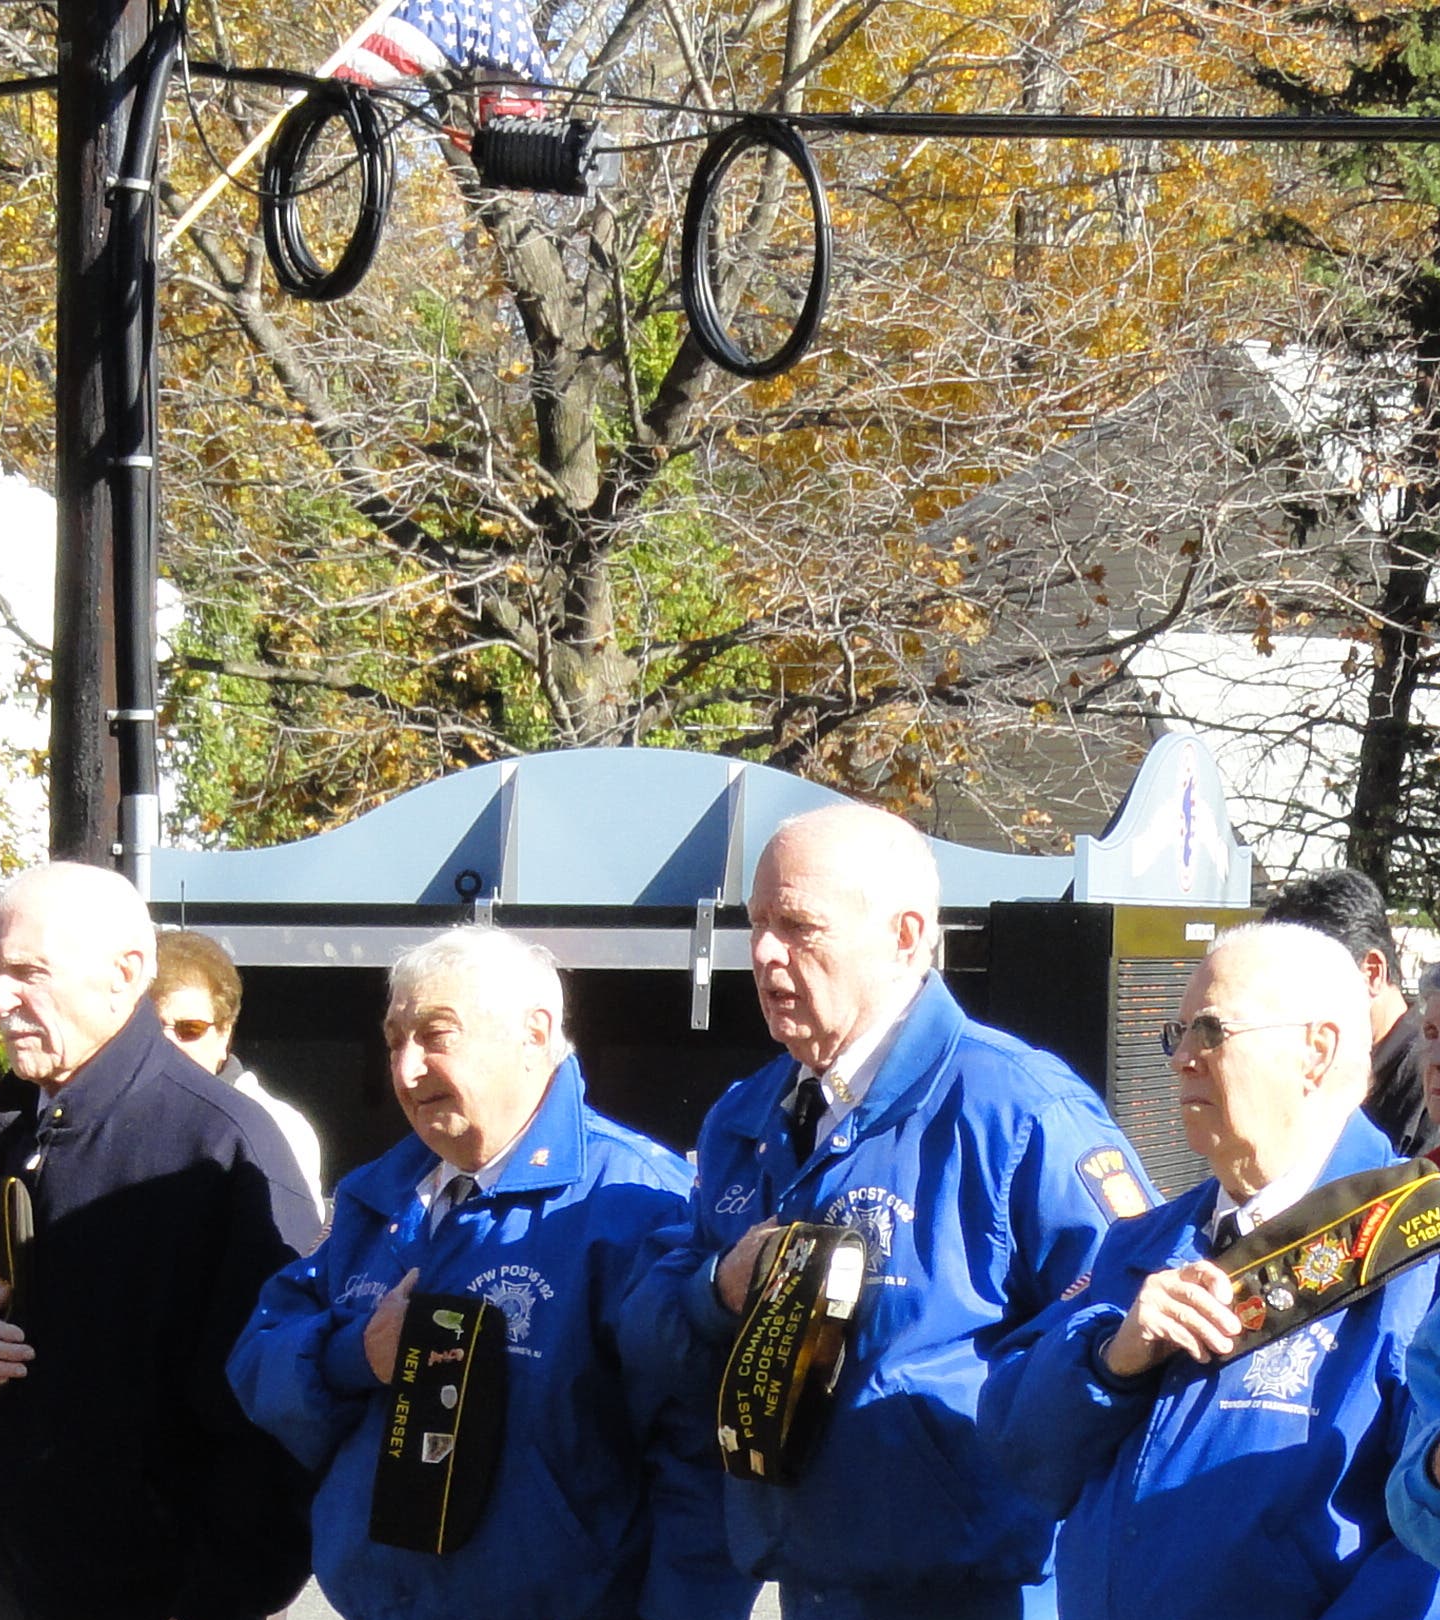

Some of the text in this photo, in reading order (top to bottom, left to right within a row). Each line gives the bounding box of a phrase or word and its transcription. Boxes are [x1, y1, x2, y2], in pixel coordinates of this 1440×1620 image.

[1083, 1149, 1125, 1180] VFW
[715, 1184, 756, 1214] Ed
[823, 1195, 847, 1225] VFW
[848, 1186, 888, 1205] POST
[1398, 1206, 1440, 1236] VFW
[466, 1268, 497, 1293] VFW
[737, 1274, 802, 1439] POST COMMANDER
[763, 1300, 806, 1418] NEW JERSEY
[388, 1347, 421, 1459] NEW JERSEY
